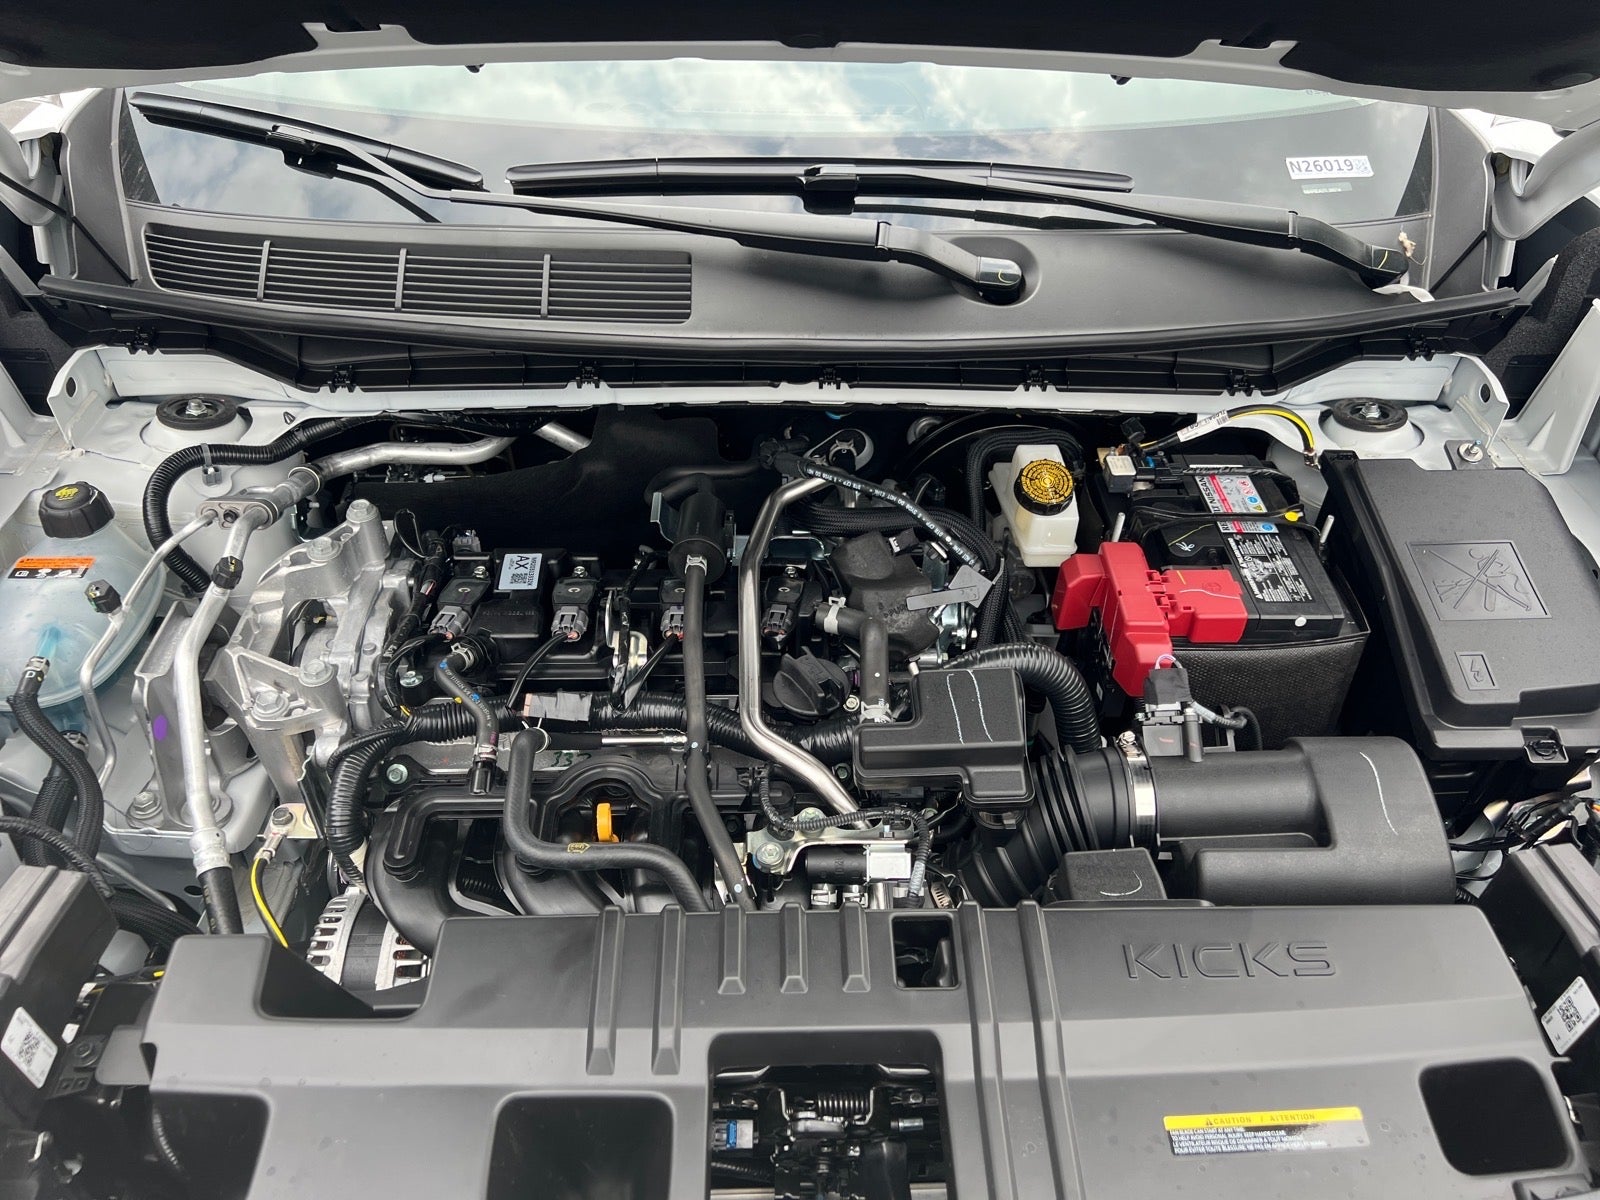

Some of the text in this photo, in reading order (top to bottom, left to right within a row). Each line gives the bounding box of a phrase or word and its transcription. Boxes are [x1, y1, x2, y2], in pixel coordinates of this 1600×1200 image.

[1288, 159, 1354, 173] N26019
[1198, 475, 1217, 505] NISSAN
[514, 554, 531, 570] AX
[1121, 940, 1337, 979] KICKS
[1213, 1116, 1252, 1125] CAUTION
[1270, 1113, 1316, 1123] ATTENTION
